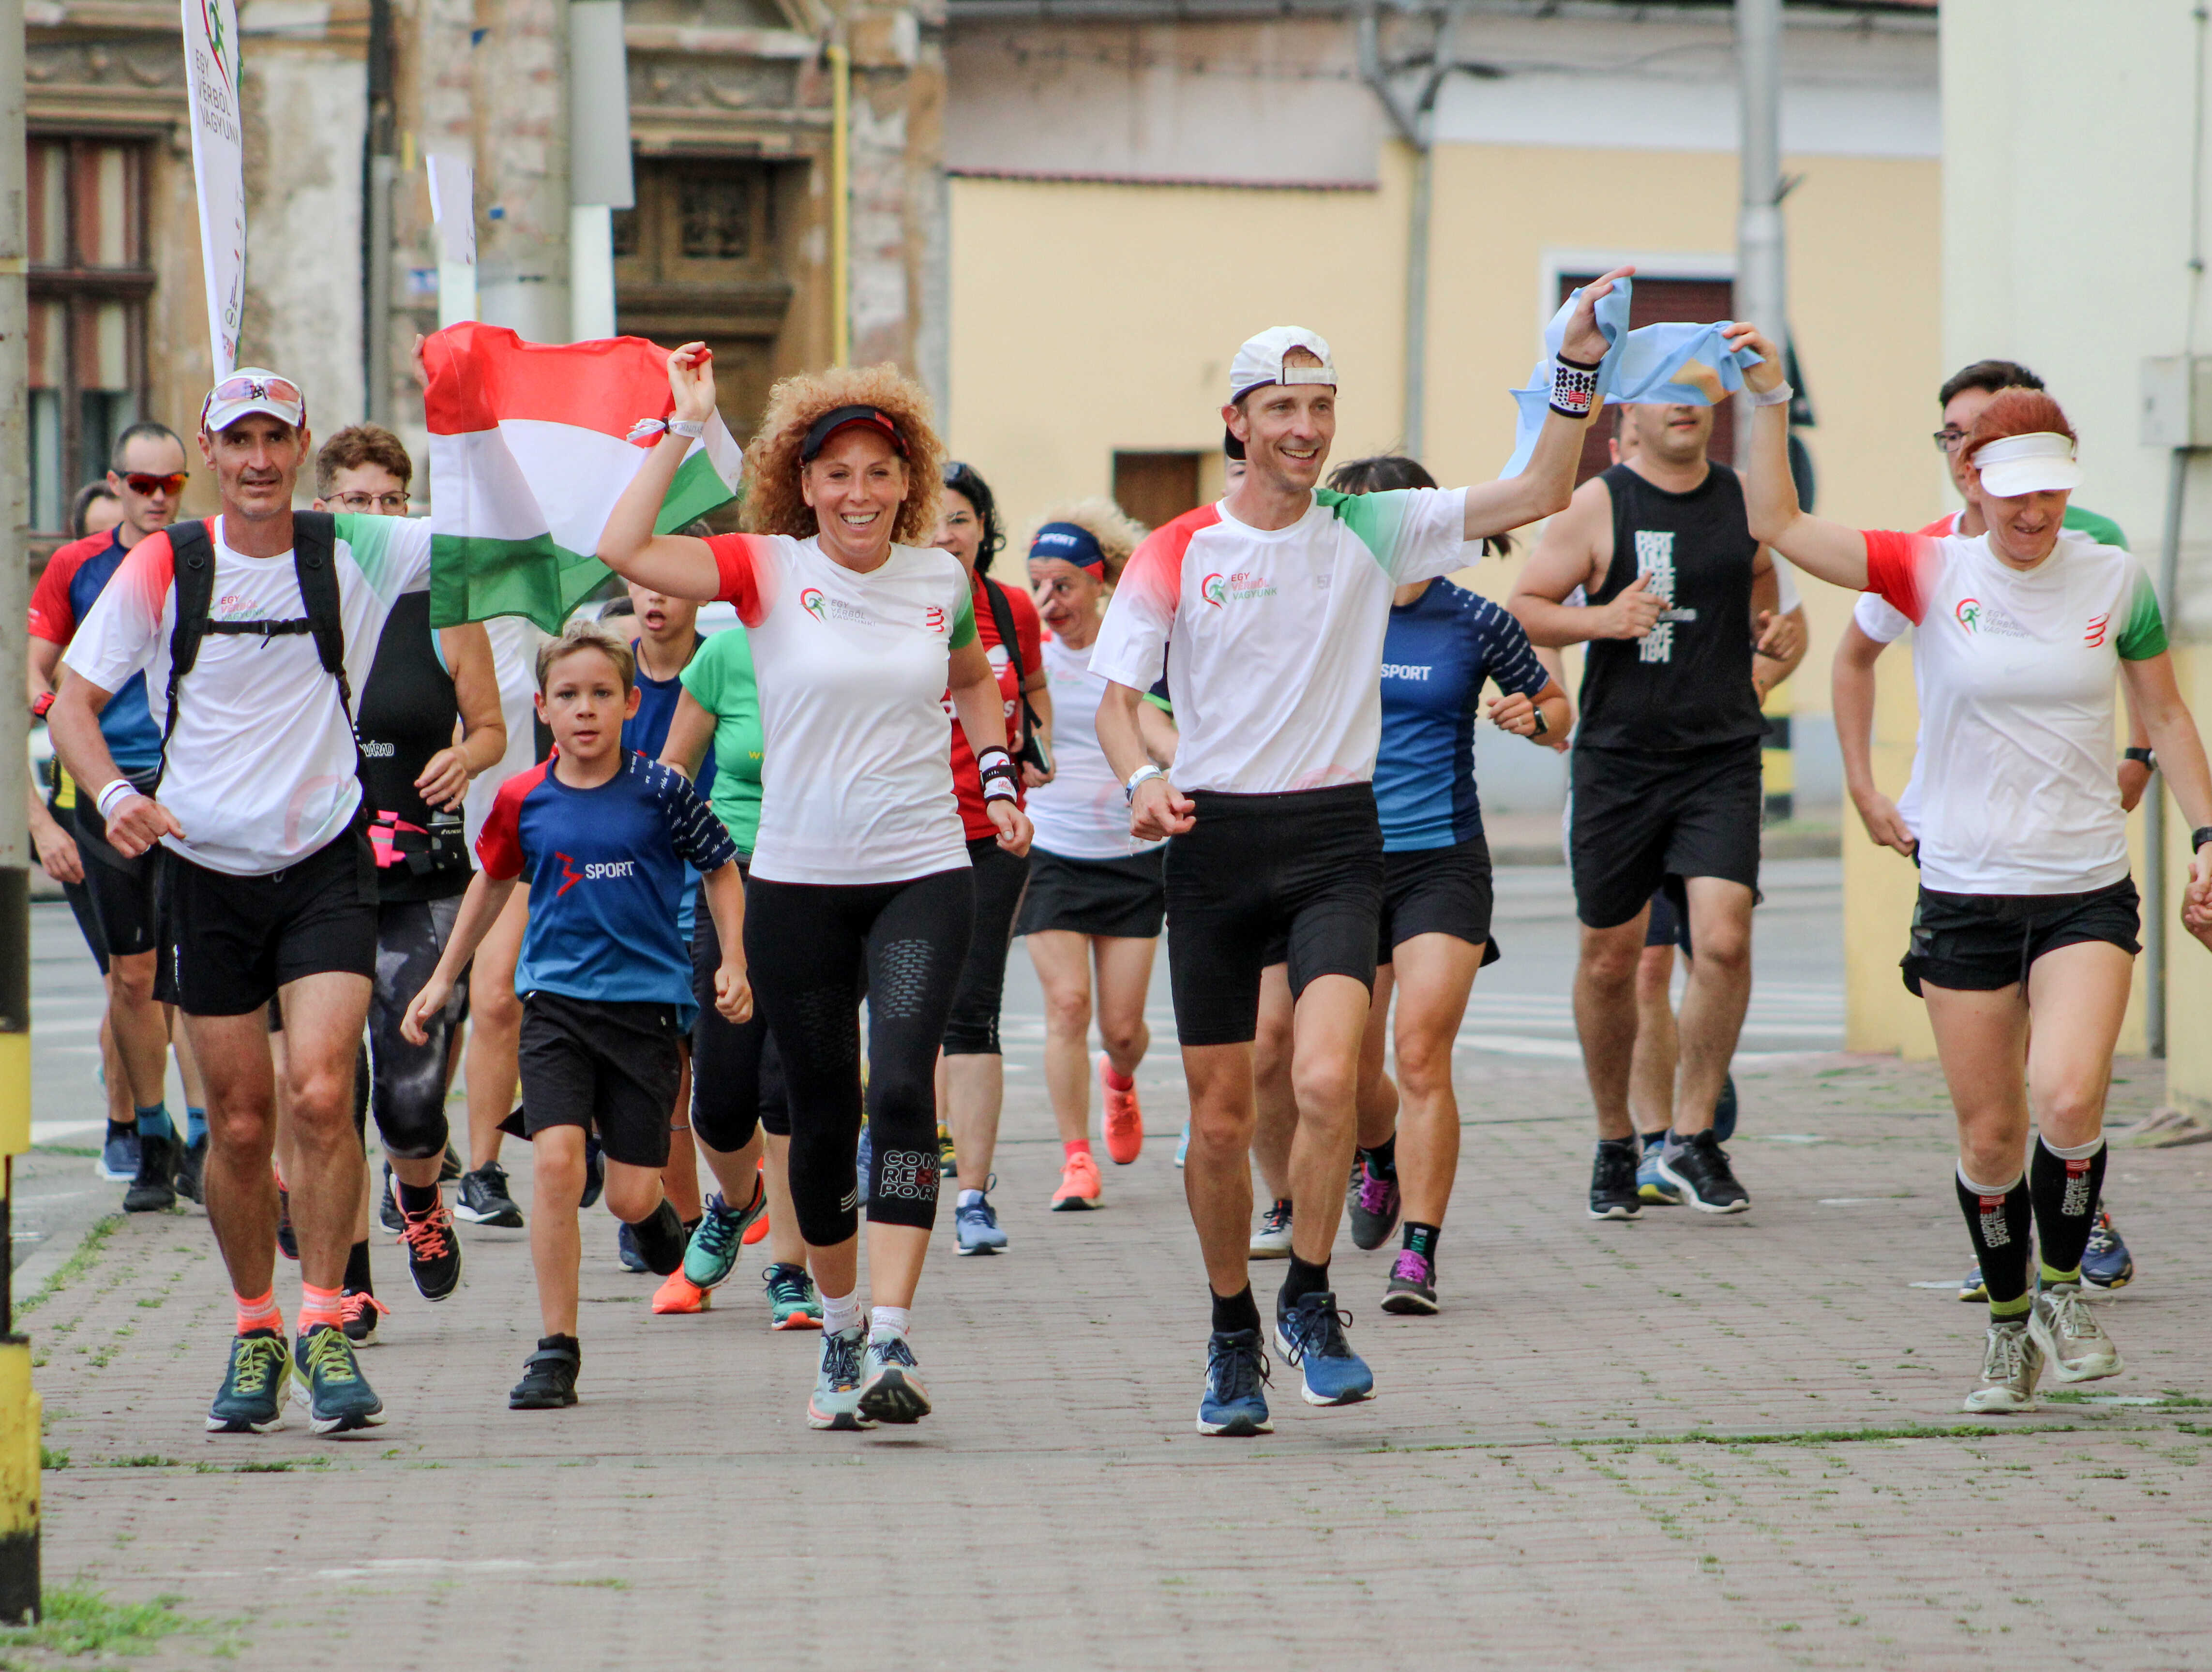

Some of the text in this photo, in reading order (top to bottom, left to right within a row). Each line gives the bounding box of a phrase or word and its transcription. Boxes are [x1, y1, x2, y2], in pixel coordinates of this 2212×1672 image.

[196, 48, 209, 76] EGY
[197, 75, 232, 117] VÉRBŐL
[1231, 572, 1250, 582] EGY
[221, 595, 241, 604] EGY
[1233, 587, 1277, 600] VAGYUNK
[831, 599, 849, 608] EGY
[1381, 663, 1432, 681] SPORT
[585, 861, 634, 879] SPORT
[884, 1150, 939, 1170] COM
